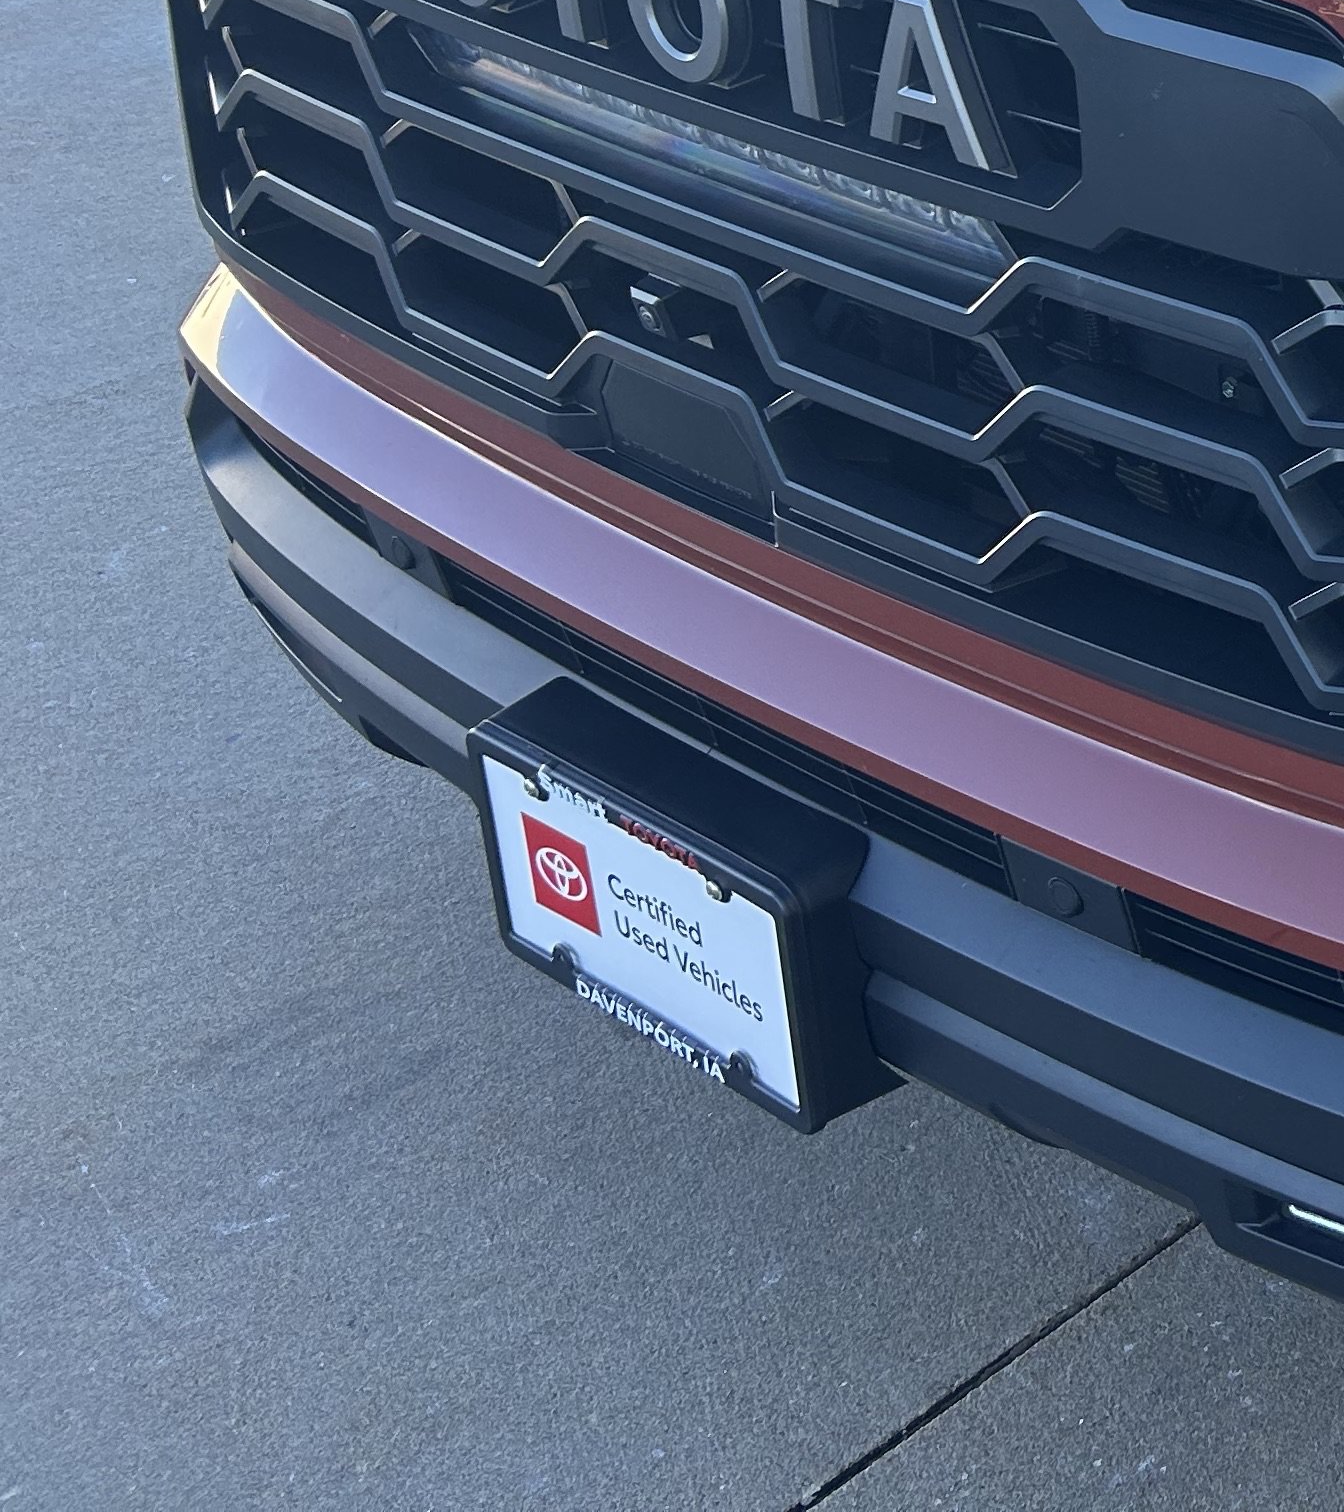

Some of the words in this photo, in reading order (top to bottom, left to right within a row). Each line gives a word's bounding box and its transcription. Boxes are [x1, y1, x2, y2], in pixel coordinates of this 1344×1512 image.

[537, 764, 608, 820] Smart
[620, 814, 698, 869] TOYOTA
[608, 874, 703, 947] Certified
[614, 910, 670, 963] Used
[673, 944, 764, 1022] Vehicles
[576, 976, 699, 1069] DAVENPORT,
[703, 1053, 726, 1084] IA
